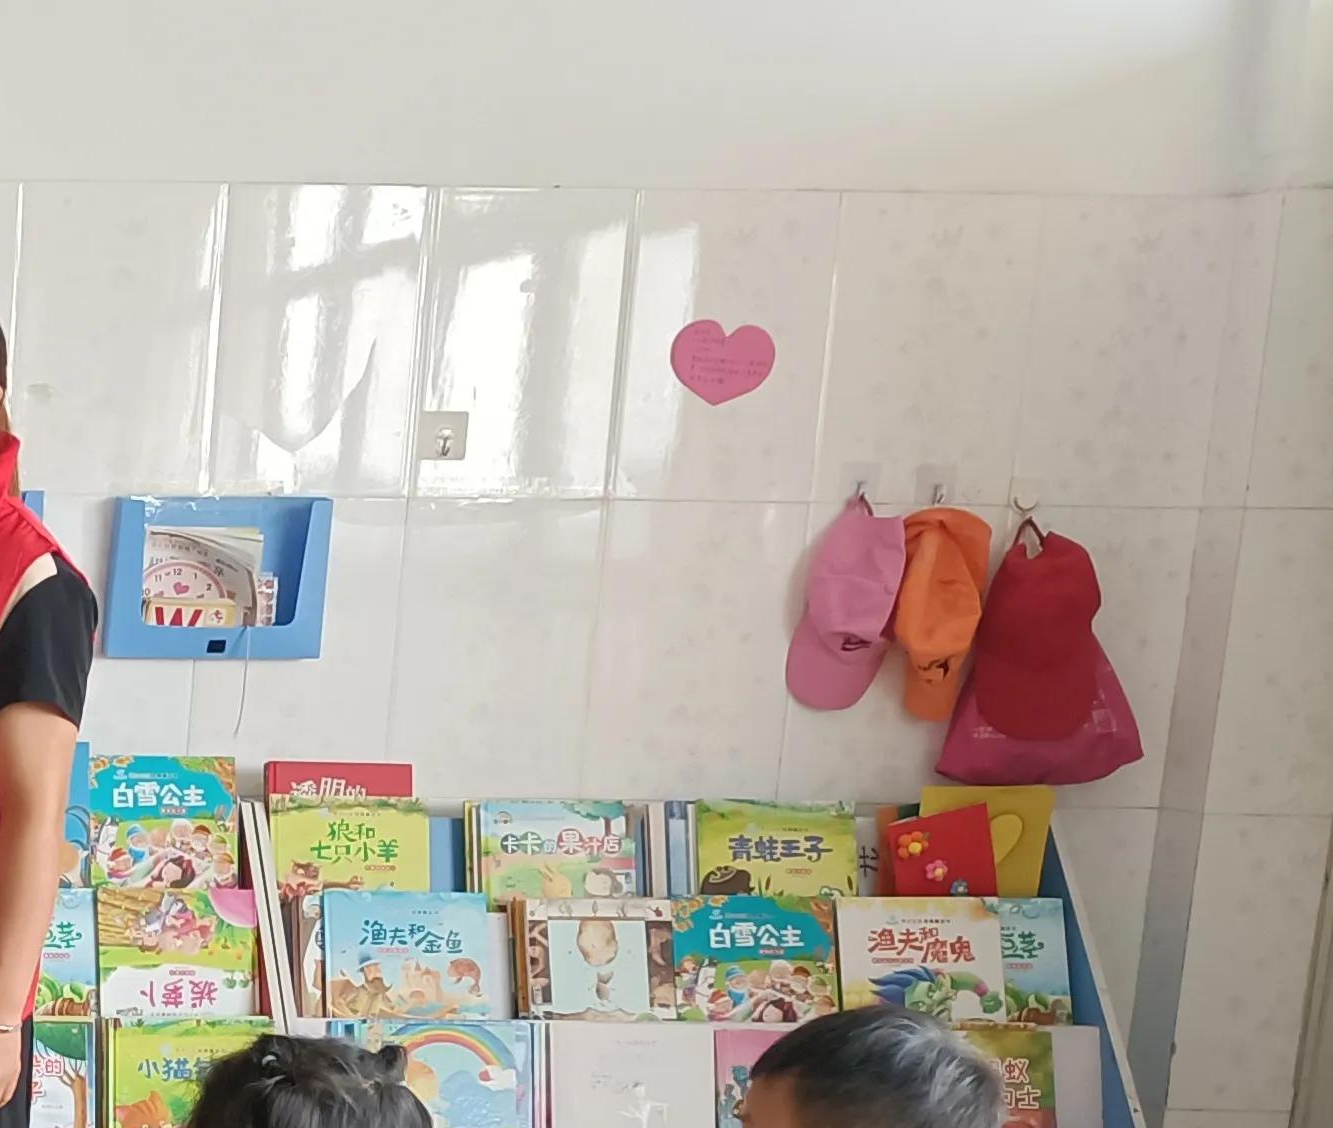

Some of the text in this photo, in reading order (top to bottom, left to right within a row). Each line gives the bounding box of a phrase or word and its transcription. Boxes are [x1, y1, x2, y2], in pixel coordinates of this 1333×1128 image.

[113, 781, 207, 808] 白雪公主
[327, 818, 376, 842] 狼和
[501, 828, 620, 857] 卡卡的果汁店
[310, 839, 399, 864] 七只小羊
[728, 834, 834, 863] 青蛙王子
[359, 919, 464, 954] 渔夫和金鱼
[709, 922, 805, 949] 白雪公主
[867, 926, 976, 964] 渔夫和魔鬼
[139, 978, 219, 1009] 拔萝卜
